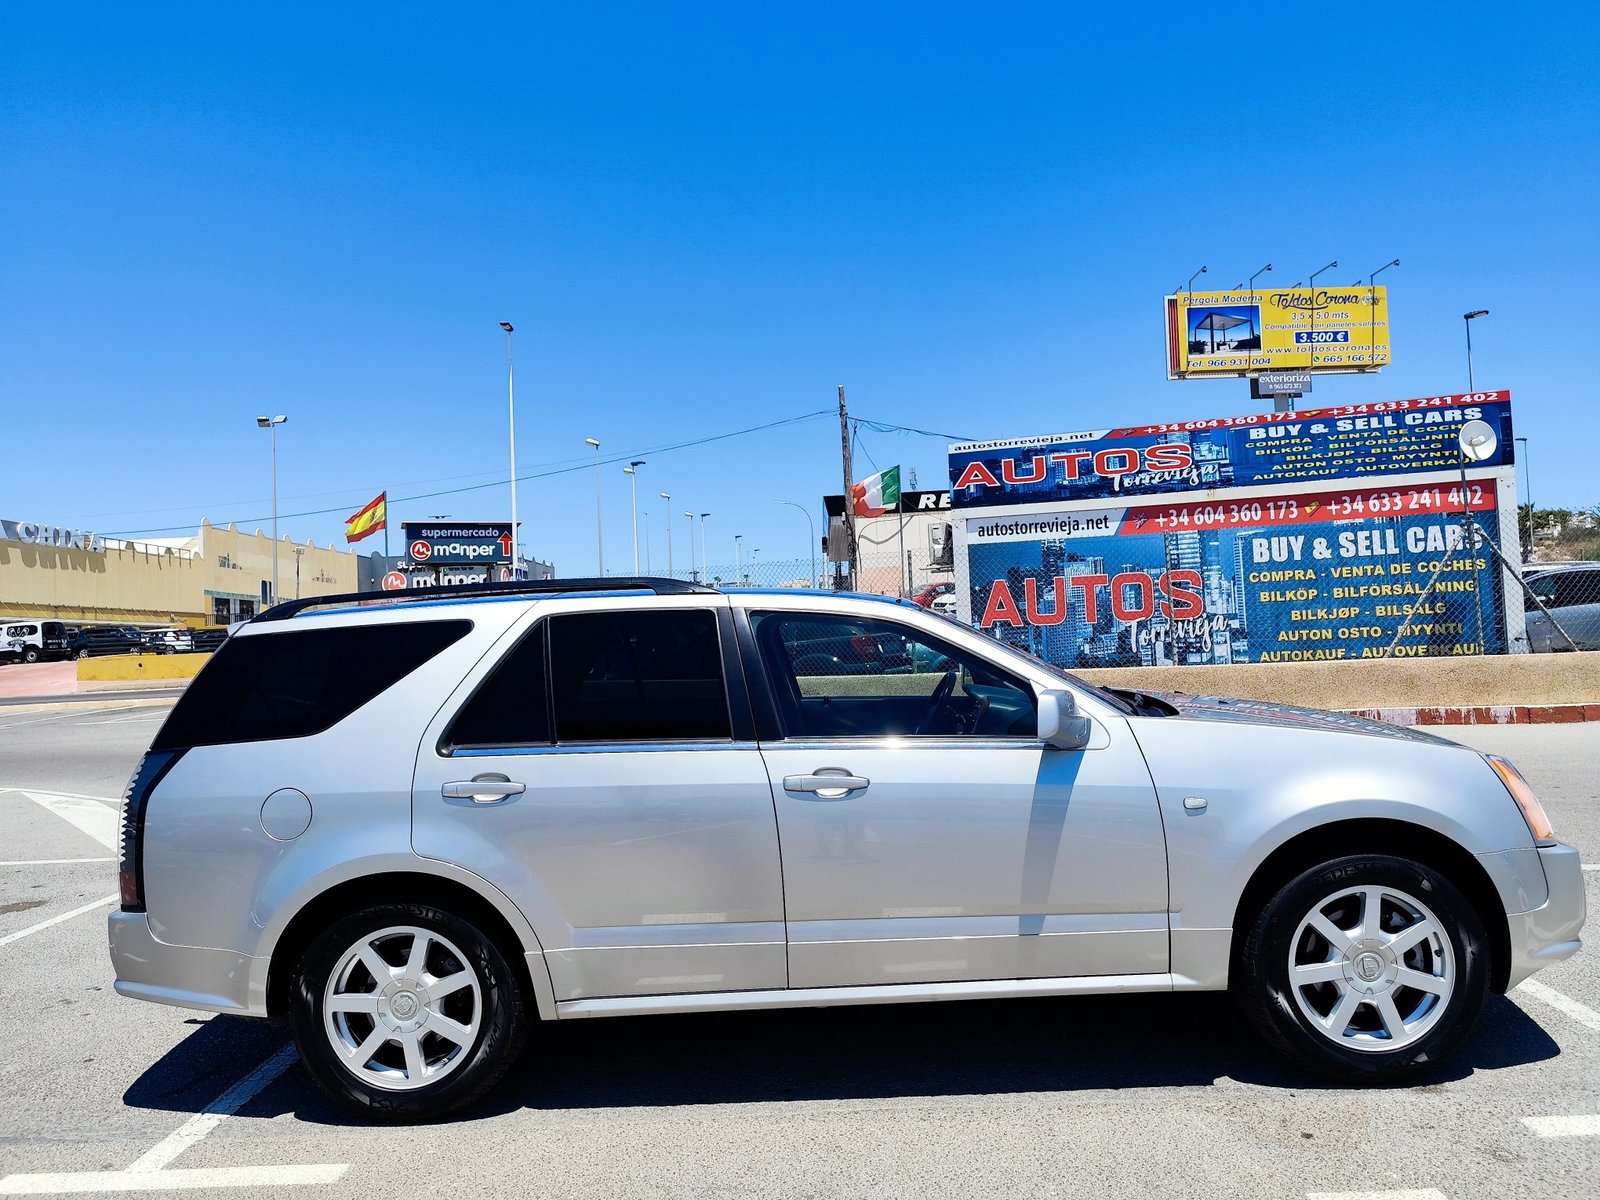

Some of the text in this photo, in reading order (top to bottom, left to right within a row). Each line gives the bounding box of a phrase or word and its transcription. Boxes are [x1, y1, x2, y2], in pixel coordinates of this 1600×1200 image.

[1222, 294, 1263, 303] Moderna
[1270, 291, 1359, 309] Toldos Corona
[1299, 332, 1334, 342] 3.500
[1207, 359, 1227, 367] 966
[1251, 357, 1271, 365] 004
[1259, 373, 1311, 383] exterioriza
[1328, 392, 1498, 416] +34 633 241 402
[1143, 412, 1298, 434] +34 604 360 173
[1249, 424, 1302, 440] BUY
[1336, 415, 1397, 432] SELL
[1406, 407, 1482, 426] CARS
[954, 431, 1094, 451] autostorrevieja.net
[1245, 437, 1312, 448] COMPRA
[1327, 431, 1381, 441] VENTA
[1415, 423, 1463, 433] COCH
[1255, 444, 1314, 456] BILKÖP
[1329, 432, 1459, 449] BILFÖRSÄLJNIN
[1272, 460, 1327, 471] AUTON
[1332, 456, 1376, 465] OSTO
[1392, 450, 1458, 460] MYYNTI
[1286, 450, 1355, 461] BILKJØP
[1370, 442, 1442, 454] BILSALG
[954, 443, 1193, 490] AUTOS
[1253, 468, 1340, 481] AUTOKAUF
[1110, 463, 1219, 492] Torrevieja
[1326, 485, 1483, 516] +34 633 241 402
[1155, 500, 1299, 528] +34 604 360 173
[17, 521, 106, 553] CHINA
[421, 527, 499, 539] supermercado
[977, 515, 1109, 538] autostorrevieja.net
[433, 543, 496, 560] manper
[1252, 534, 1305, 563] BUY
[1312, 537, 1332, 559] &
[1338, 526, 1400, 558] SELL
[1249, 569, 1316, 583] COMPRA
[1330, 564, 1385, 578] VENTA
[1391, 563, 1412, 575] DE
[1417, 558, 1487, 574] COCHES
[980, 569, 1203, 628] AUTOS
[1260, 588, 1318, 602] BILKÖP
[1291, 607, 1360, 621] BILKJØP
[1375, 603, 1446, 617] BILSALG
[1278, 628, 1333, 642] AUTON
[1338, 626, 1382, 638] OSTO
[1260, 648, 1346, 663] AUTOKAUF
